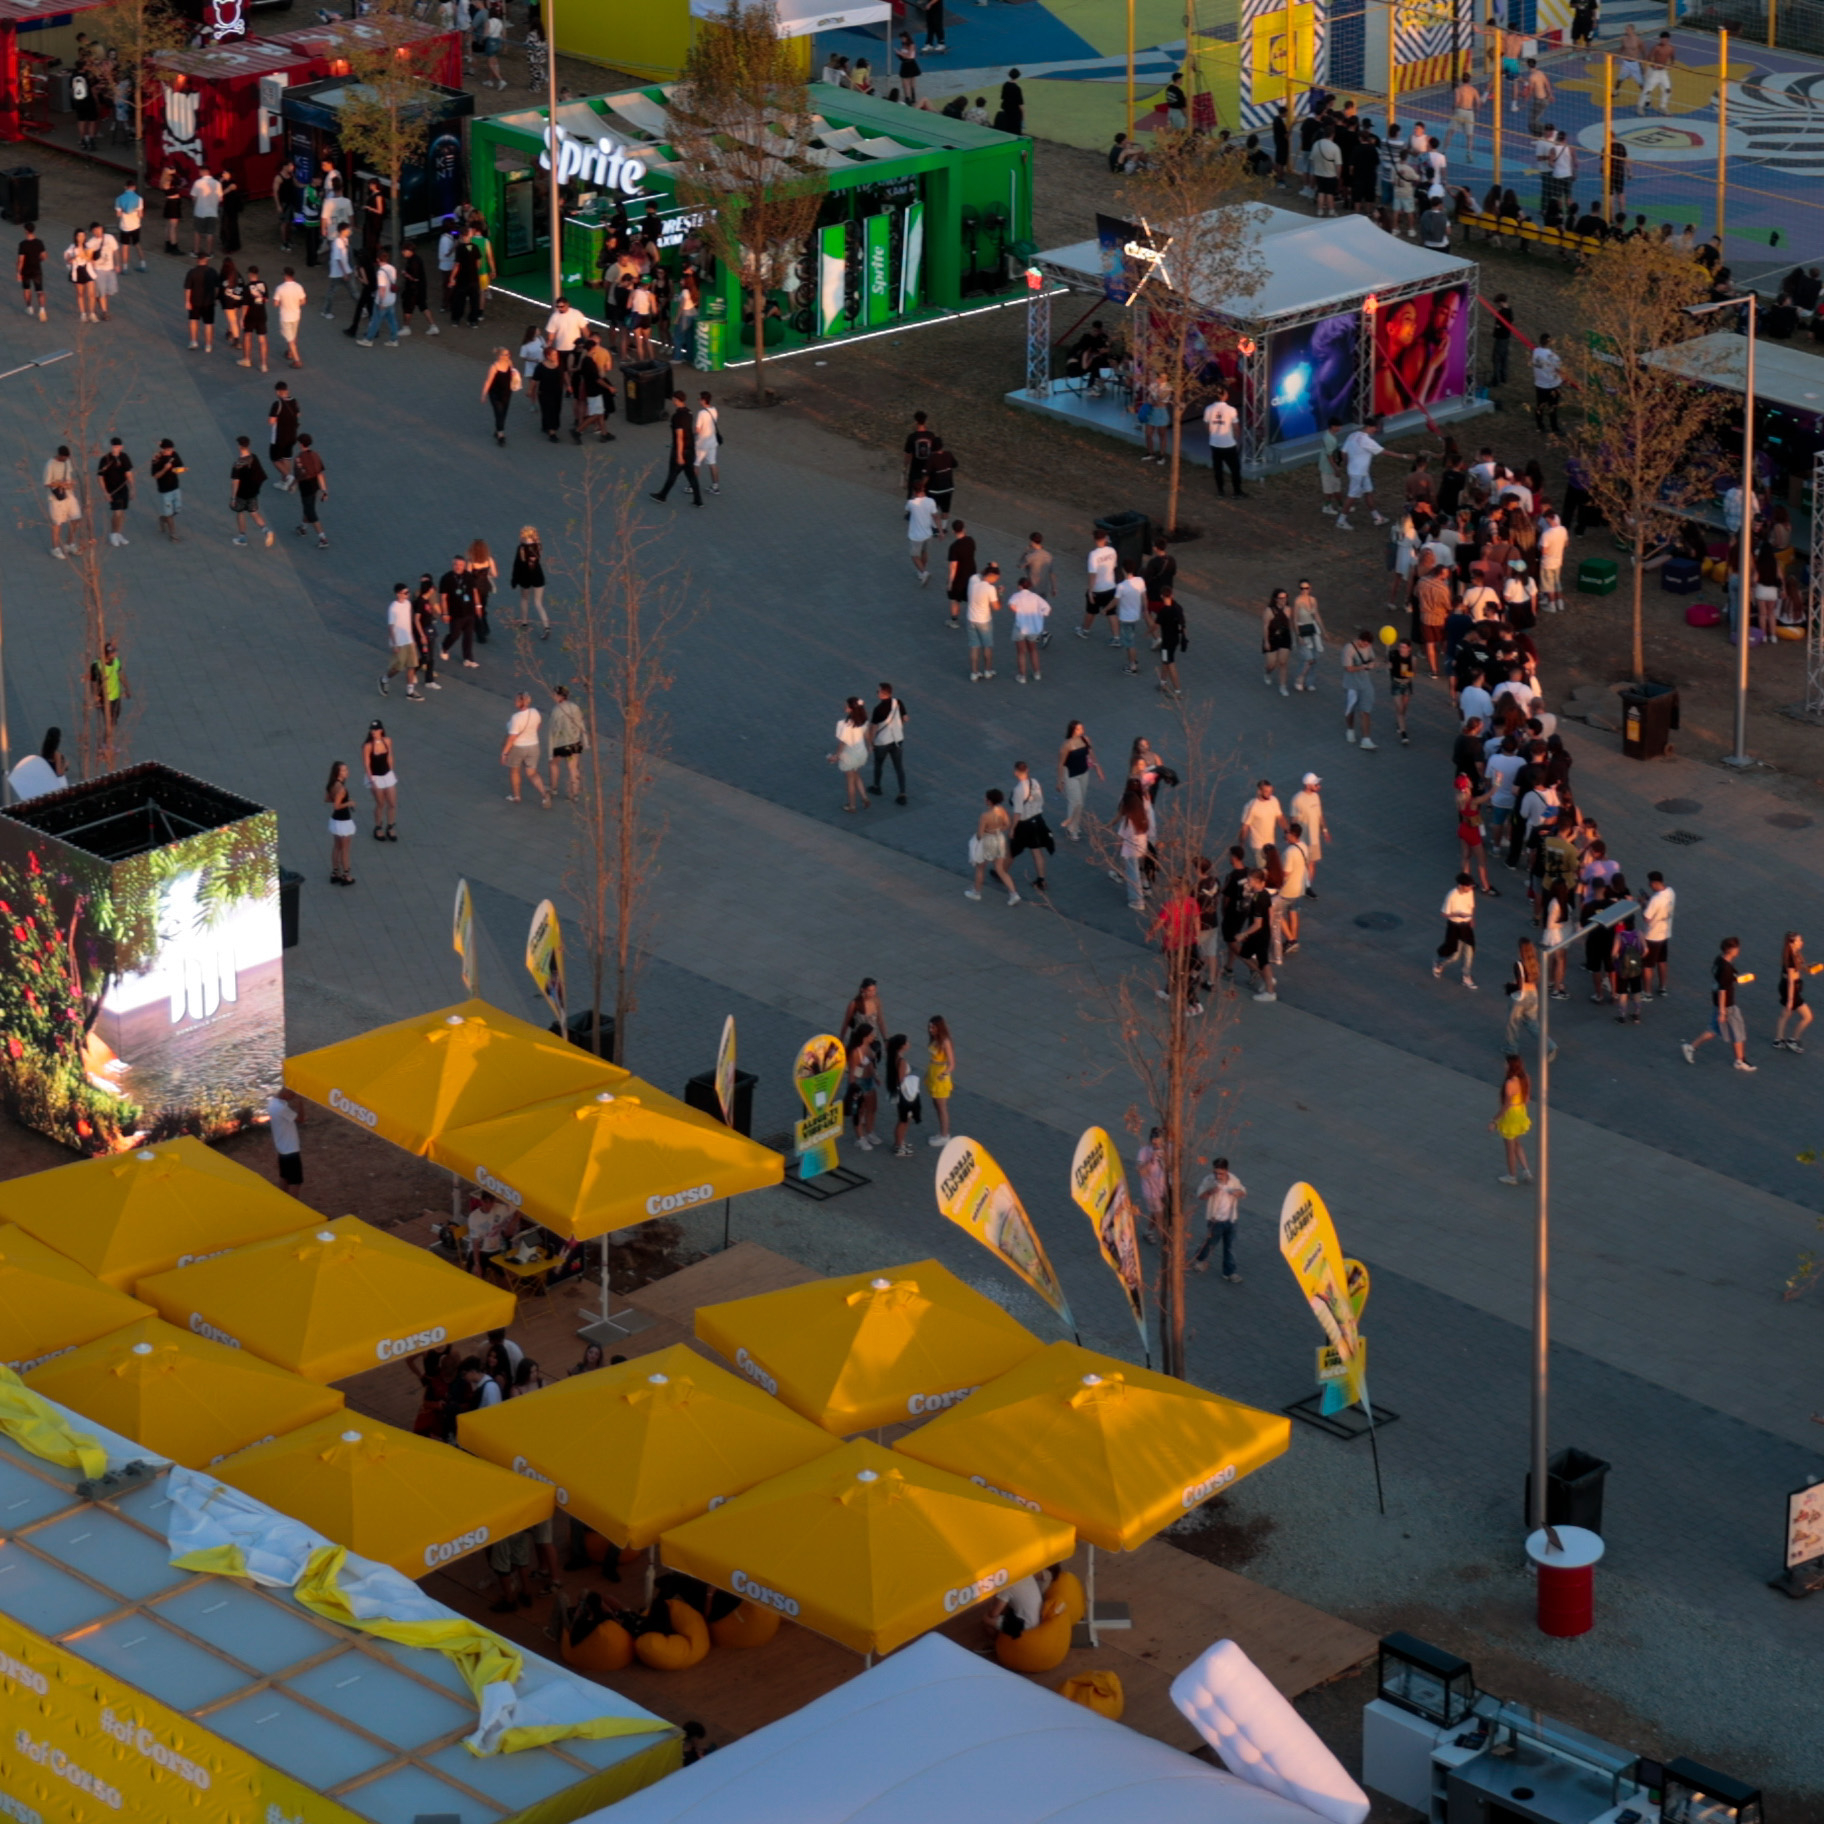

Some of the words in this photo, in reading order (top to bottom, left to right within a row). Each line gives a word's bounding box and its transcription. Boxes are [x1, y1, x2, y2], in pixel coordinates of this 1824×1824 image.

[540, 122, 647, 196] Sprite
[872, 244, 885, 295] Sprite
[1124, 240, 1167, 264] durex
[328, 1087, 378, 1127] Corso
[475, 1165, 522, 1206] Corso
[645, 1181, 715, 1217] Corso
[188, 1312, 242, 1350] Corso
[376, 1324, 447, 1361] Corso
[734, 1347, 778, 1395] Corso
[1181, 1464, 1238, 1509] Corso
[423, 1524, 490, 1569] Corso
[729, 1569, 802, 1618] Corso
[942, 1569, 1010, 1613] Corso
